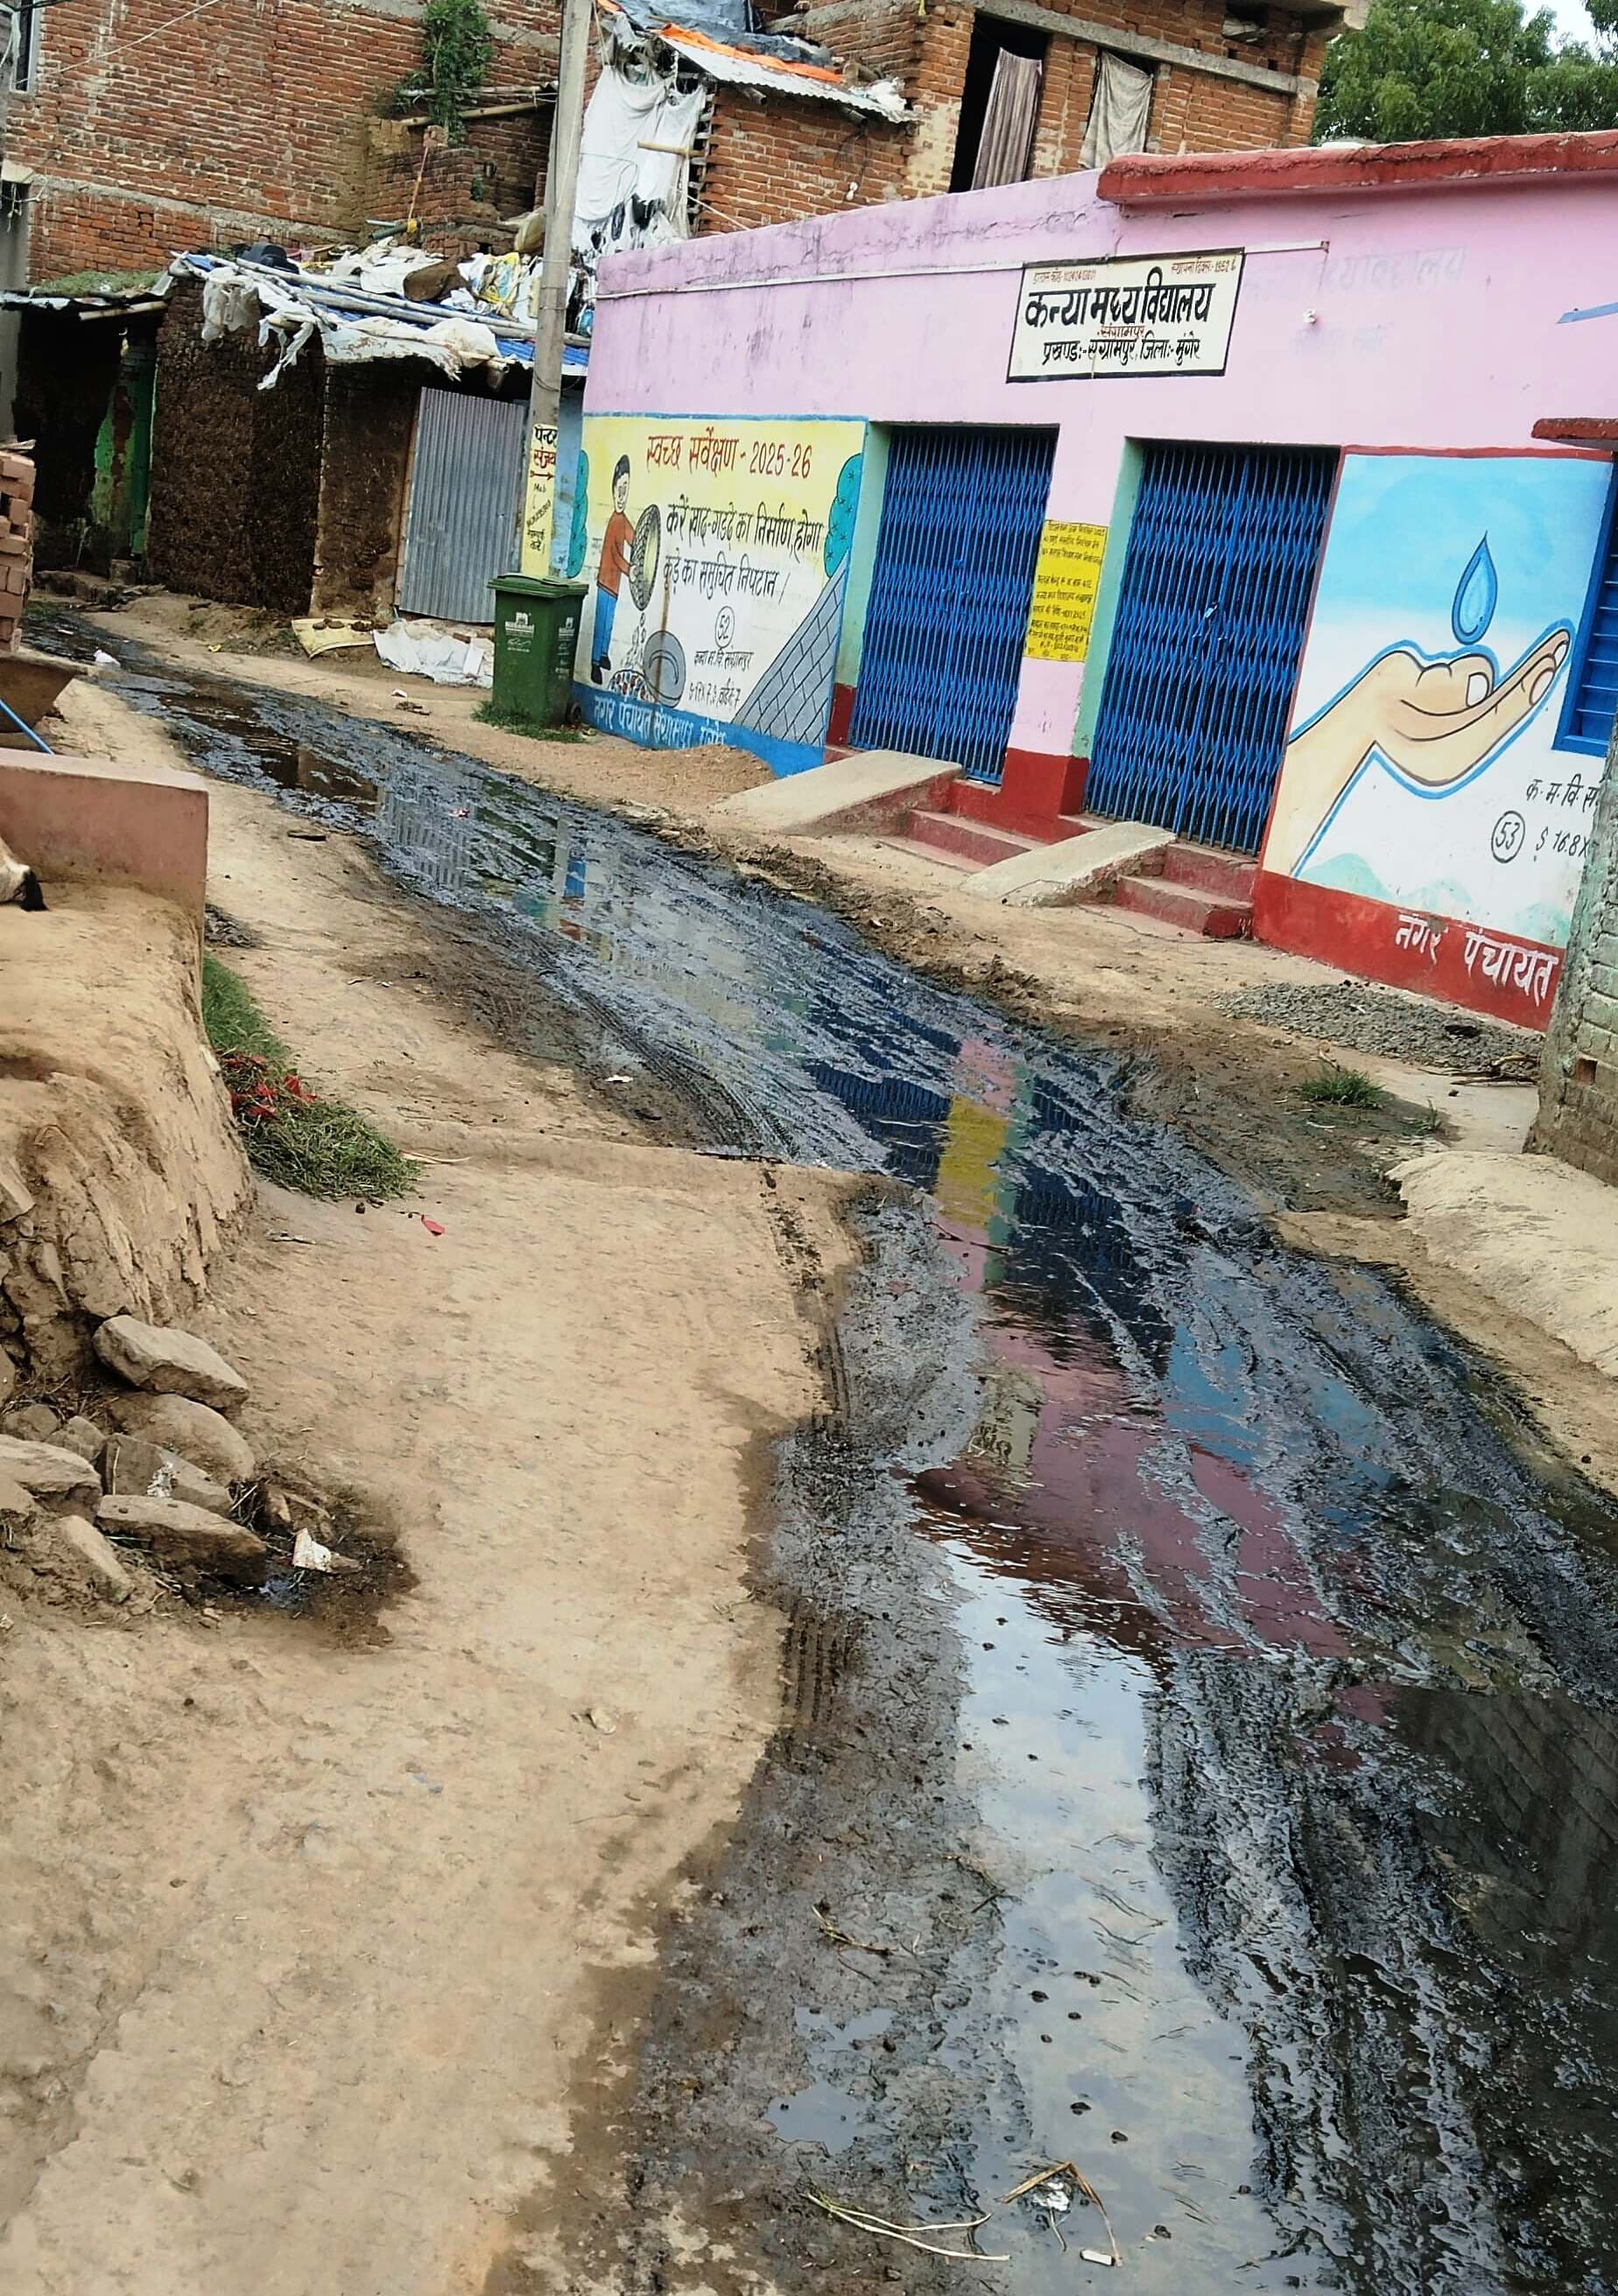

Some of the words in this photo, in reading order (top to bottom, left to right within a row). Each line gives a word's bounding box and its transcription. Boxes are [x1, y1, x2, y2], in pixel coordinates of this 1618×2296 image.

[1025, 288, 1092, 328] कन्या
[1090, 285, 1143, 326] मध्य
[1140, 266, 1216, 325] विद्यालय
[646, 435, 684, 474] स्वच्छ
[689, 426, 740, 478] सर्वेक्षण
[749, 440, 813, 480] 2025-26
[665, 494, 690, 541] करें
[735, 510, 755, 544] का
[793, 509, 825, 564] होगा
[681, 558, 700, 586] का
[737, 553, 781, 598] निपटान
[717, 621, 733, 641] 52
[594, 695, 616, 731] नगर
[618, 696, 654, 741] पंचायत
[1495, 821, 1521, 851] 53
[1396, 913, 1448, 965] नगर
[1464, 928, 1558, 1007] पंचायत
